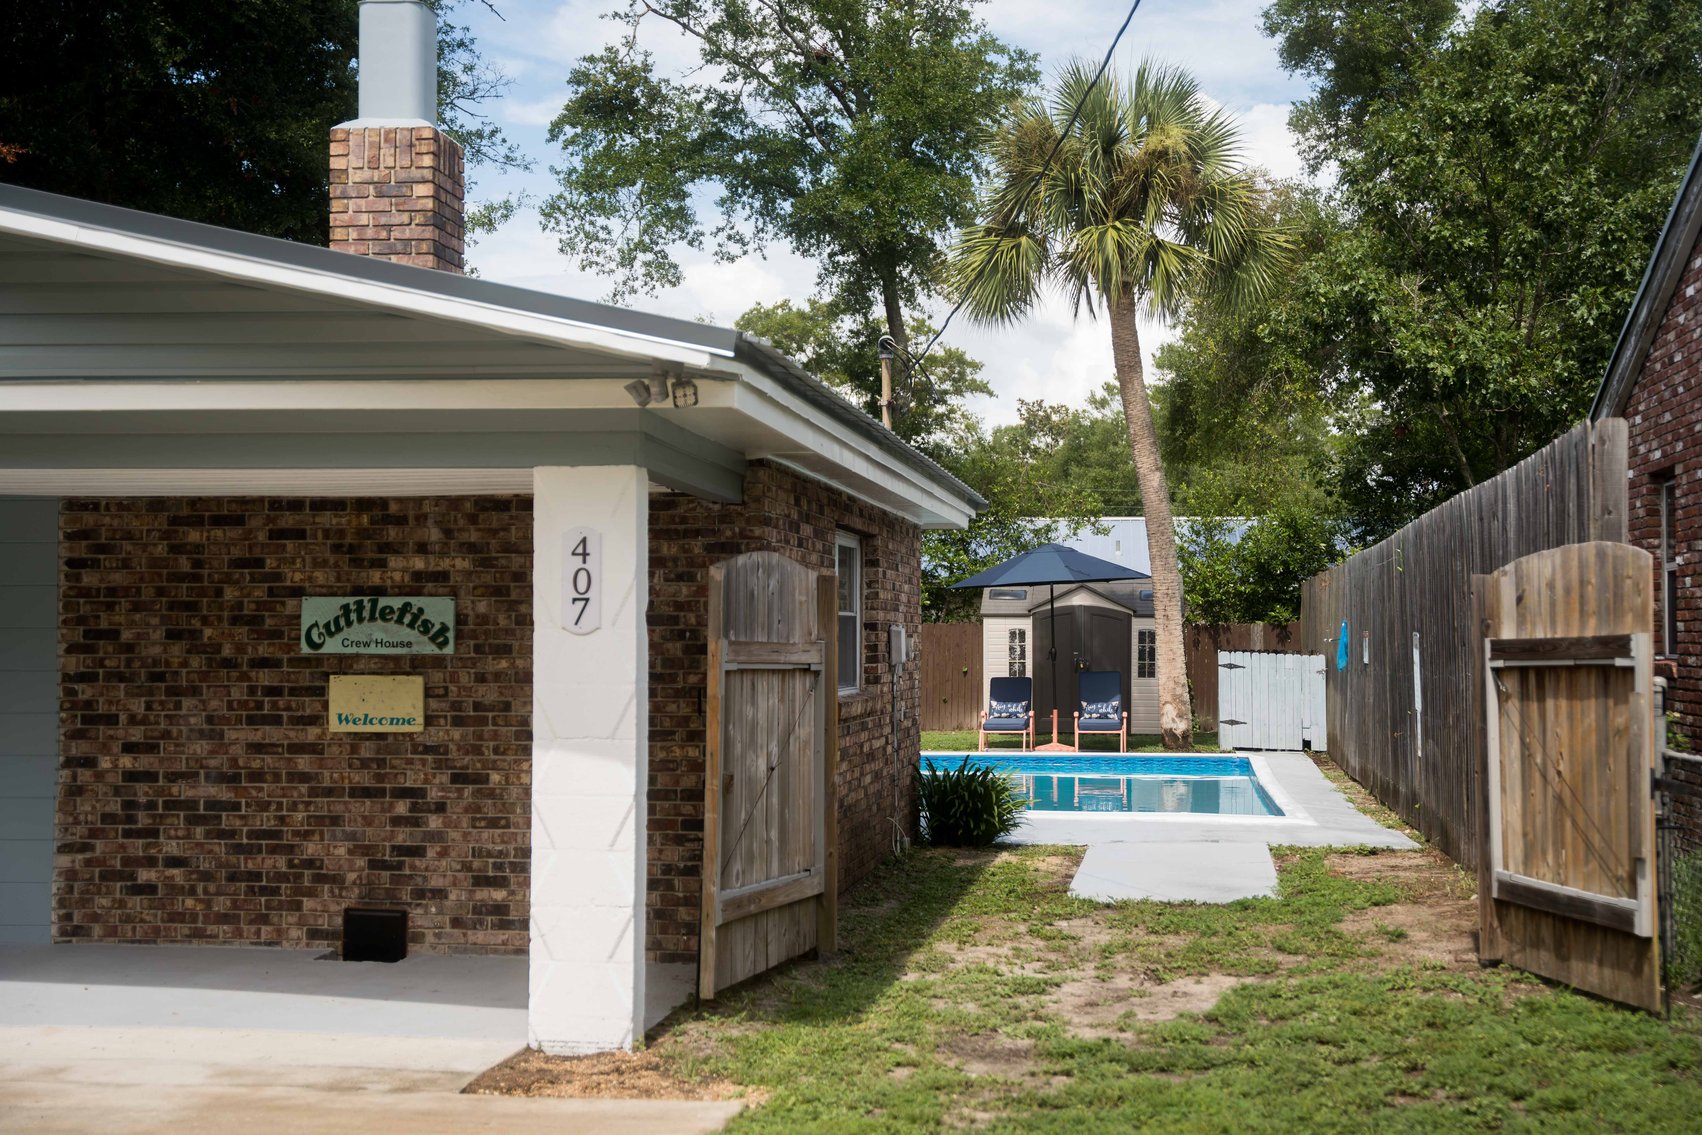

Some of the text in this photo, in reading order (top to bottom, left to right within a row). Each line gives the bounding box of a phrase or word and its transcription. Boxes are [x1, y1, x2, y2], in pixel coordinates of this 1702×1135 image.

[571, 536, 592, 626] 407
[304, 598, 450, 651] Cuttlefish
[341, 638, 413, 649] Crew House
[336, 713, 417, 726] Welcome
